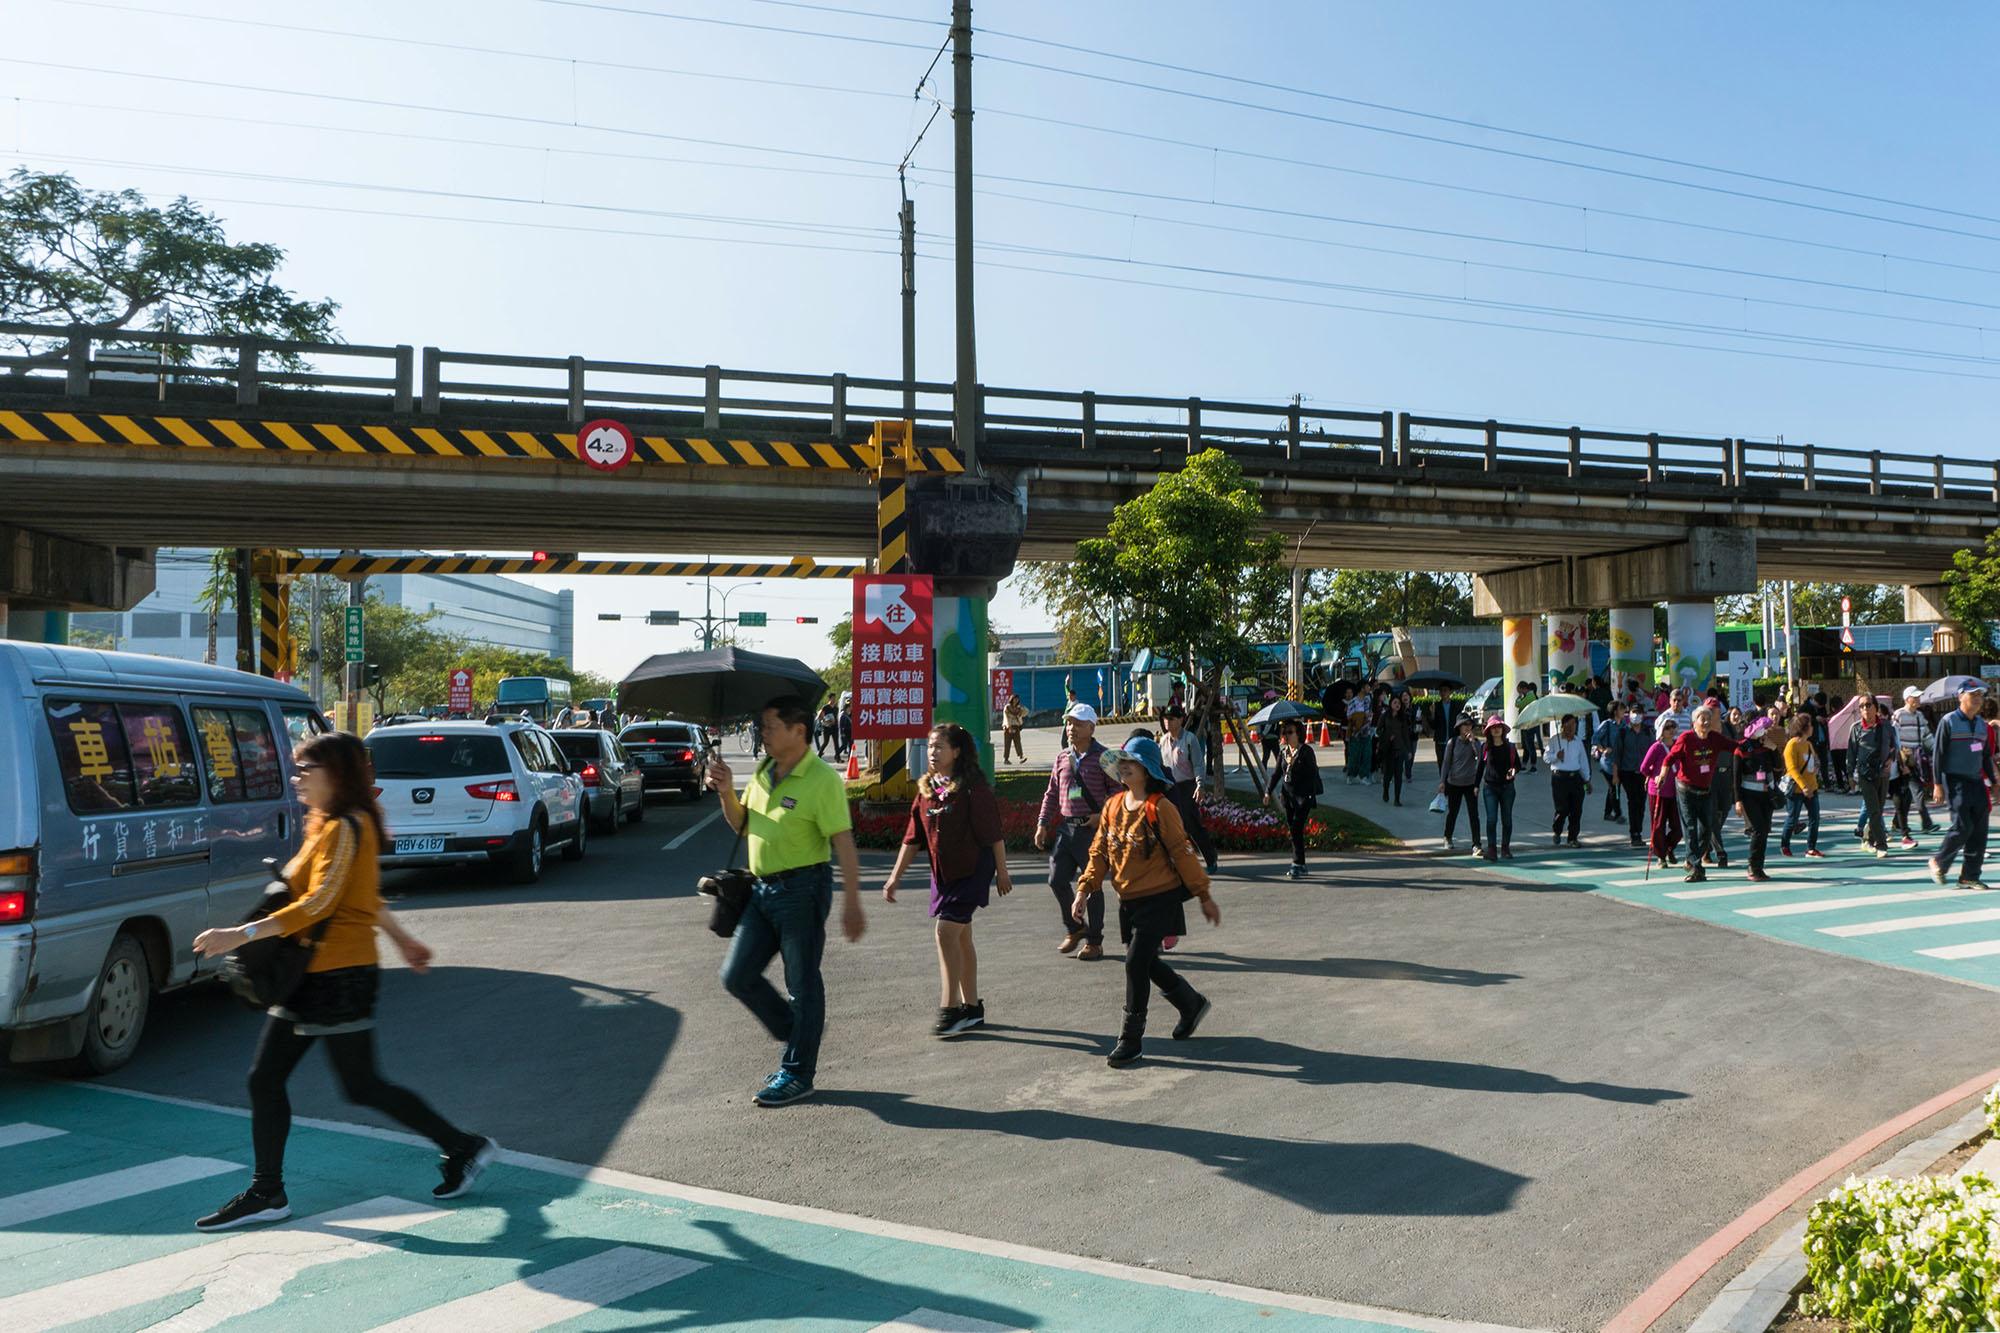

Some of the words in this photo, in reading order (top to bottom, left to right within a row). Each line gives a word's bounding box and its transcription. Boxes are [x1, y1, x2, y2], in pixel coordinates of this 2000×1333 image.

[588, 438, 614, 452] 4.2
[886, 604, 906, 623] 往
[861, 643, 924, 663] 接駁車
[860, 670, 924, 684] 后里火車站
[860, 688, 924, 705] 麗寶樂園
[860, 709, 924, 725] 外埔園區
[396, 838, 444, 851] RBV-6187
